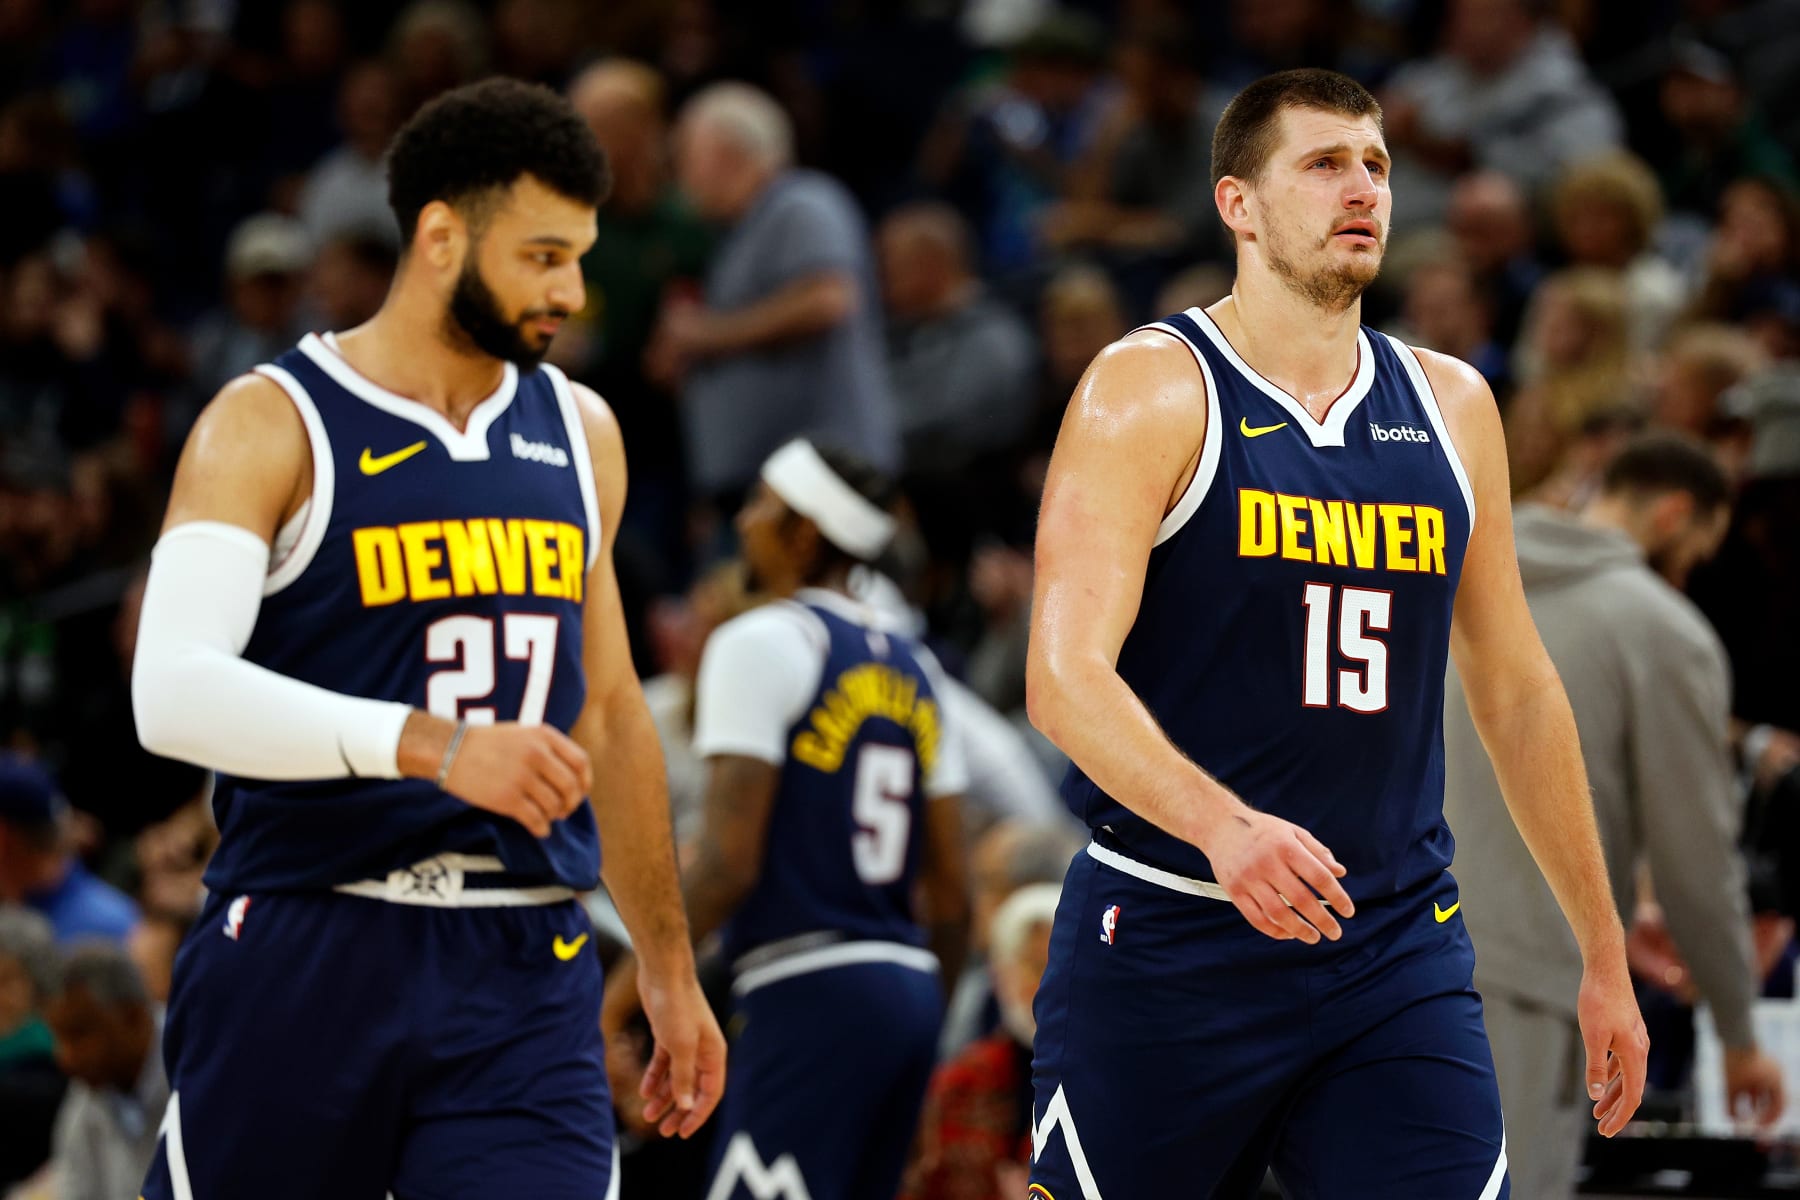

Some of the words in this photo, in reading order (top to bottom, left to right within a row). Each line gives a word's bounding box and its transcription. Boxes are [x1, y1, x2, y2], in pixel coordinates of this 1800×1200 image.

[1369, 422, 1431, 443] ibotta
[352, 518, 584, 607] DENVER
[1238, 488, 1447, 577] DENVER
[425, 612, 560, 726] 27
[1302, 581, 1394, 714] 15
[852, 742, 914, 884] 5
